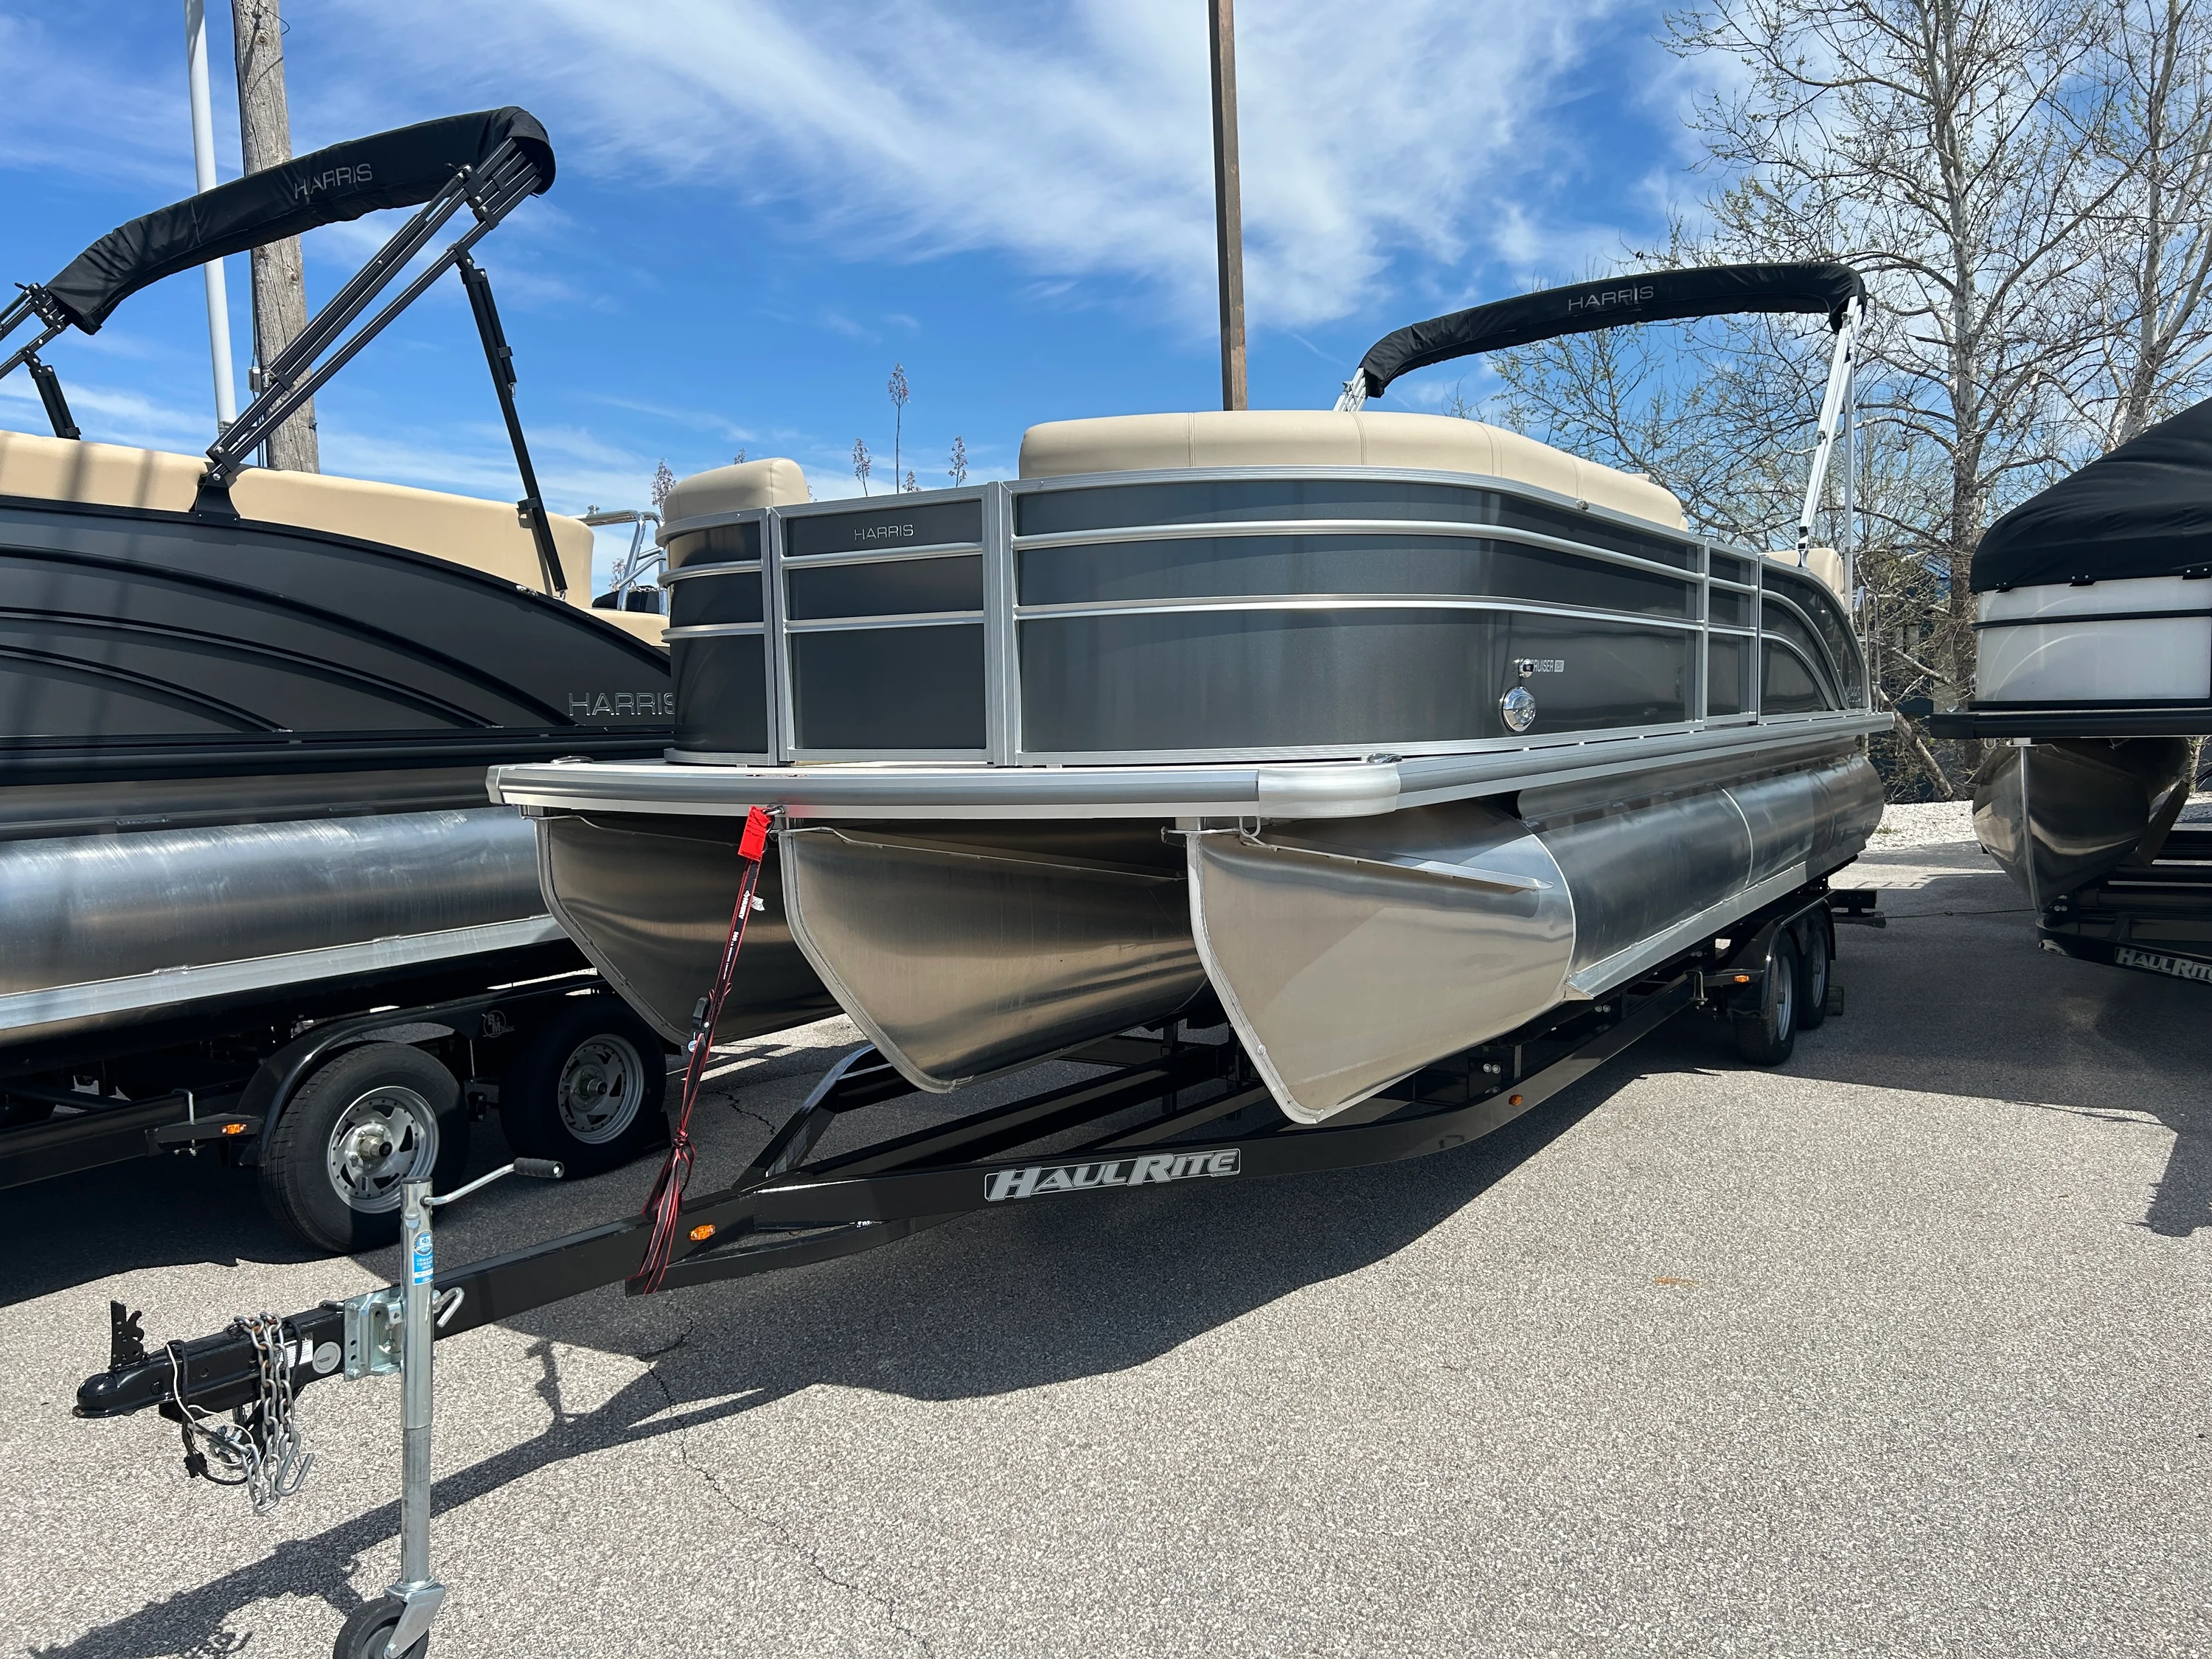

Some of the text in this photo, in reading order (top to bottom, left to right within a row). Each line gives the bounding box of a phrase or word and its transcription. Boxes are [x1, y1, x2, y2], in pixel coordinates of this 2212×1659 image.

[295, 163, 373, 200] HARRIS
[1568, 285, 1655, 311] HARRIS
[854, 524, 914, 540] HARRIS
[1531, 659, 1554, 672] RUISER
